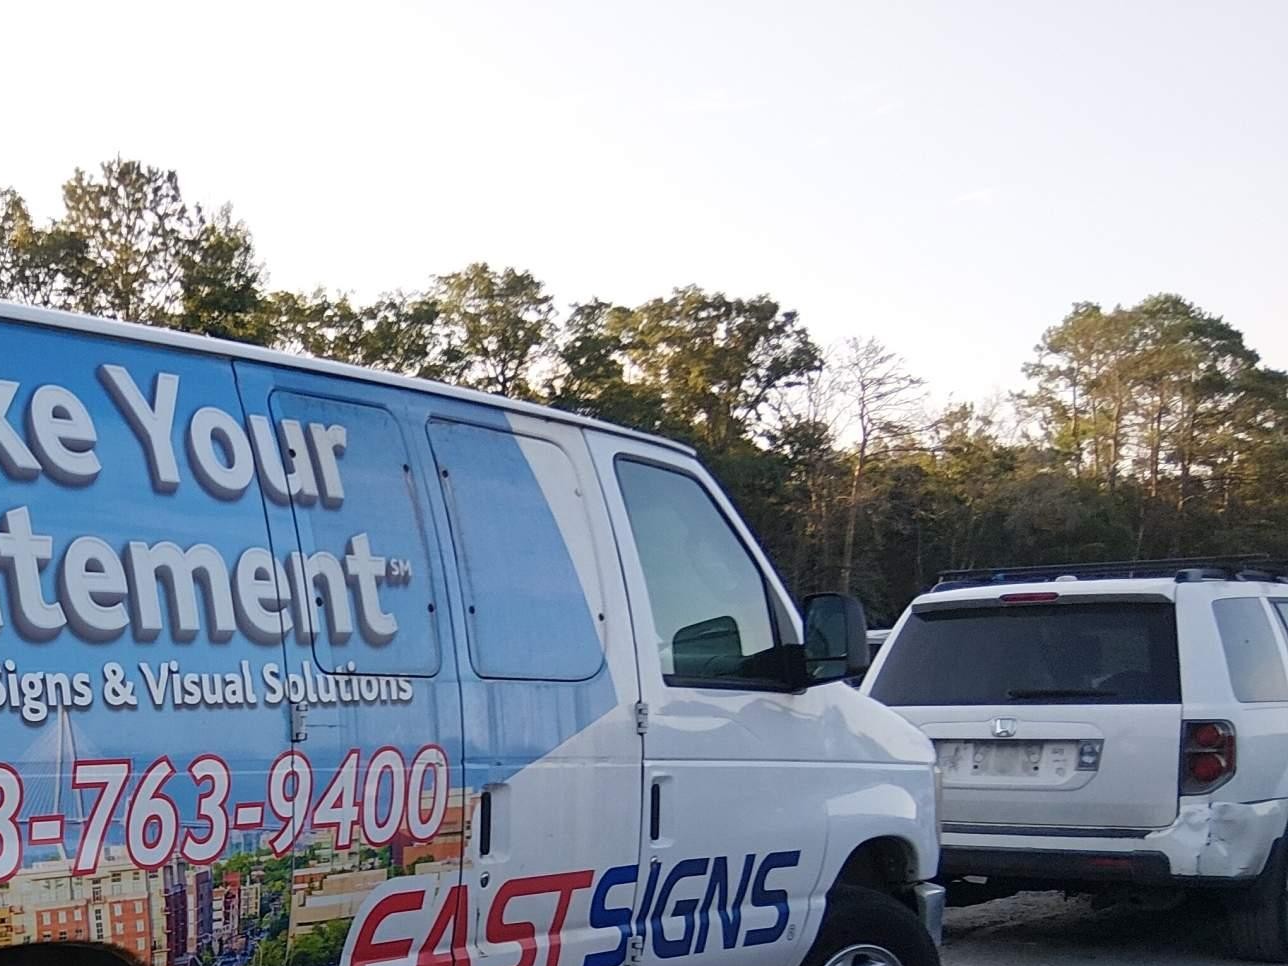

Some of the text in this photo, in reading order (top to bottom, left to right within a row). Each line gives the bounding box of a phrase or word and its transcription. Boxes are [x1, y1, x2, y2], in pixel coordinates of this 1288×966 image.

[99, 364, 347, 509] Your
[102, 661, 138, 707] &
[139, 660, 258, 708] Visual
[262, 660, 414, 708] Solutions
